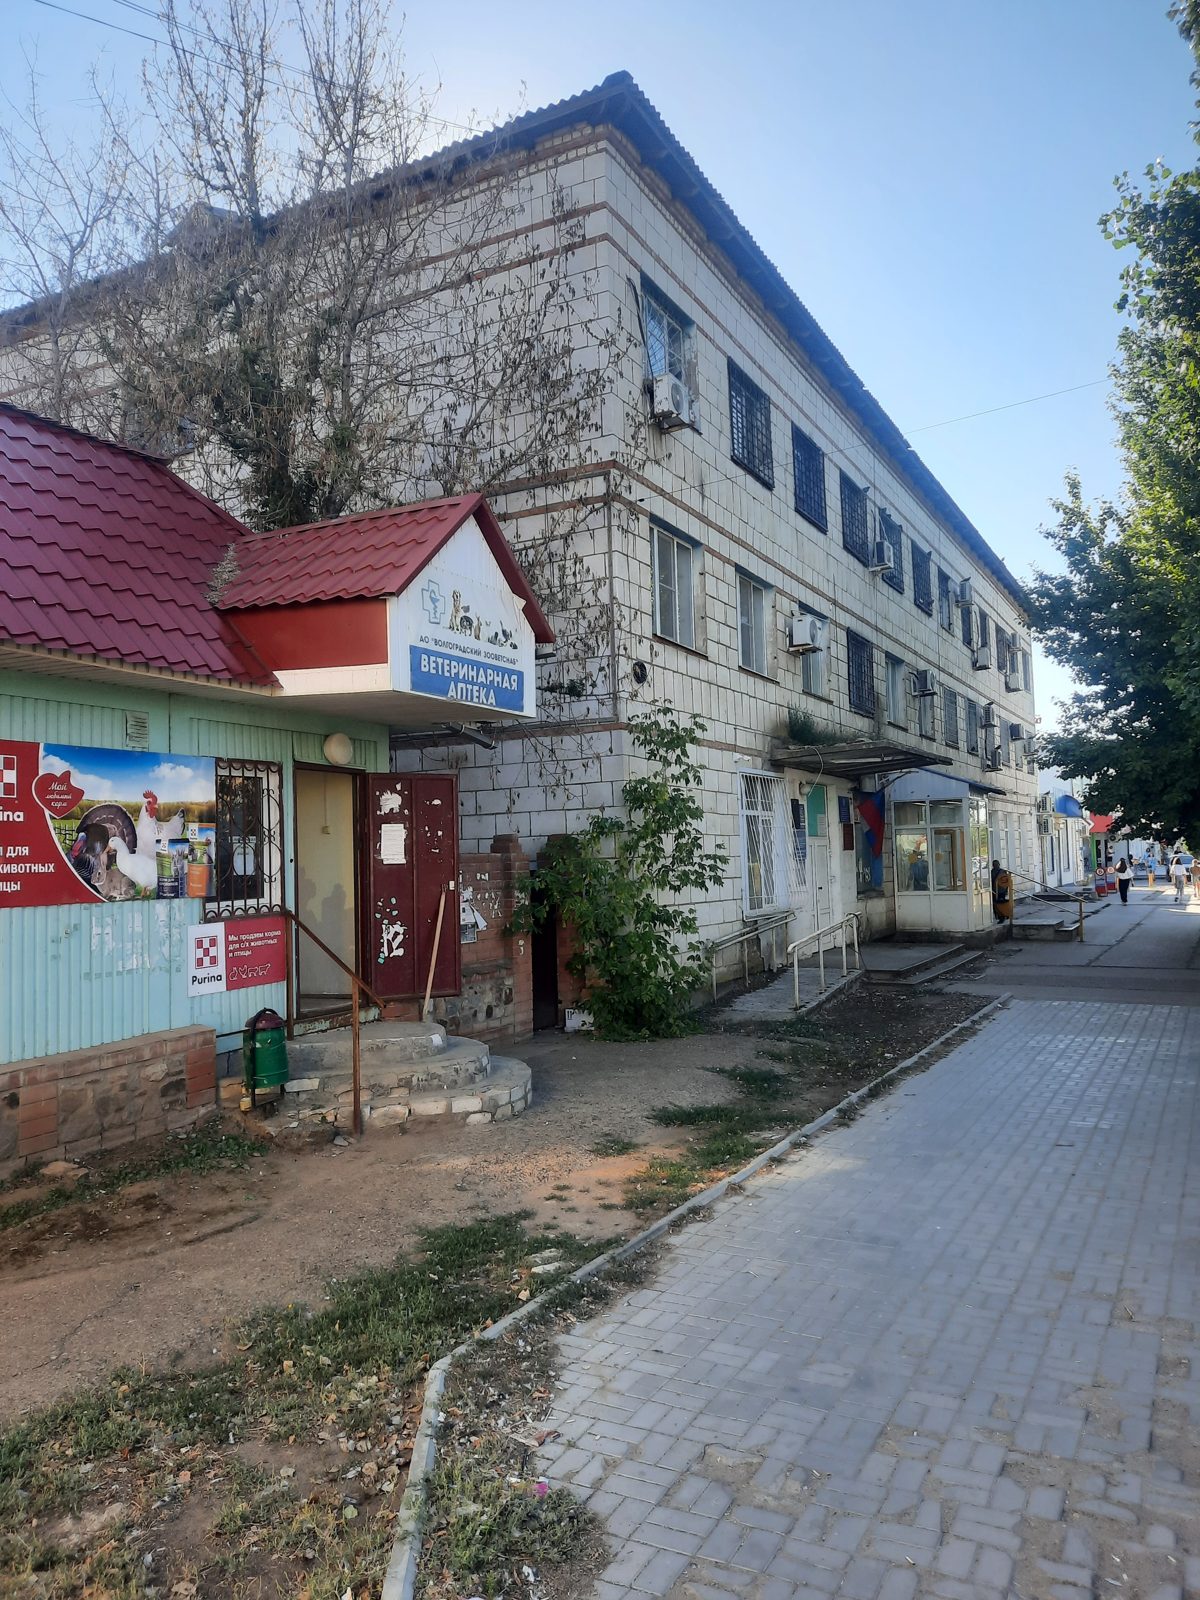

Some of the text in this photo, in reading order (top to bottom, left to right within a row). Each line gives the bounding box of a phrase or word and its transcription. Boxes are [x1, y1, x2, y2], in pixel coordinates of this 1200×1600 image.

[419, 635, 430, 644] АО
[432, 638, 482, 657] "ВОЛГОГРАДСКИЙ
[420, 653, 518, 691] ВЕТЕРИНАРНАЯ
[447, 680, 497, 706] АПТЕКА
[48, 781, 68, 791] Мой
[240, 940, 249, 948] с/х
[191, 973, 223, 986] Purina
